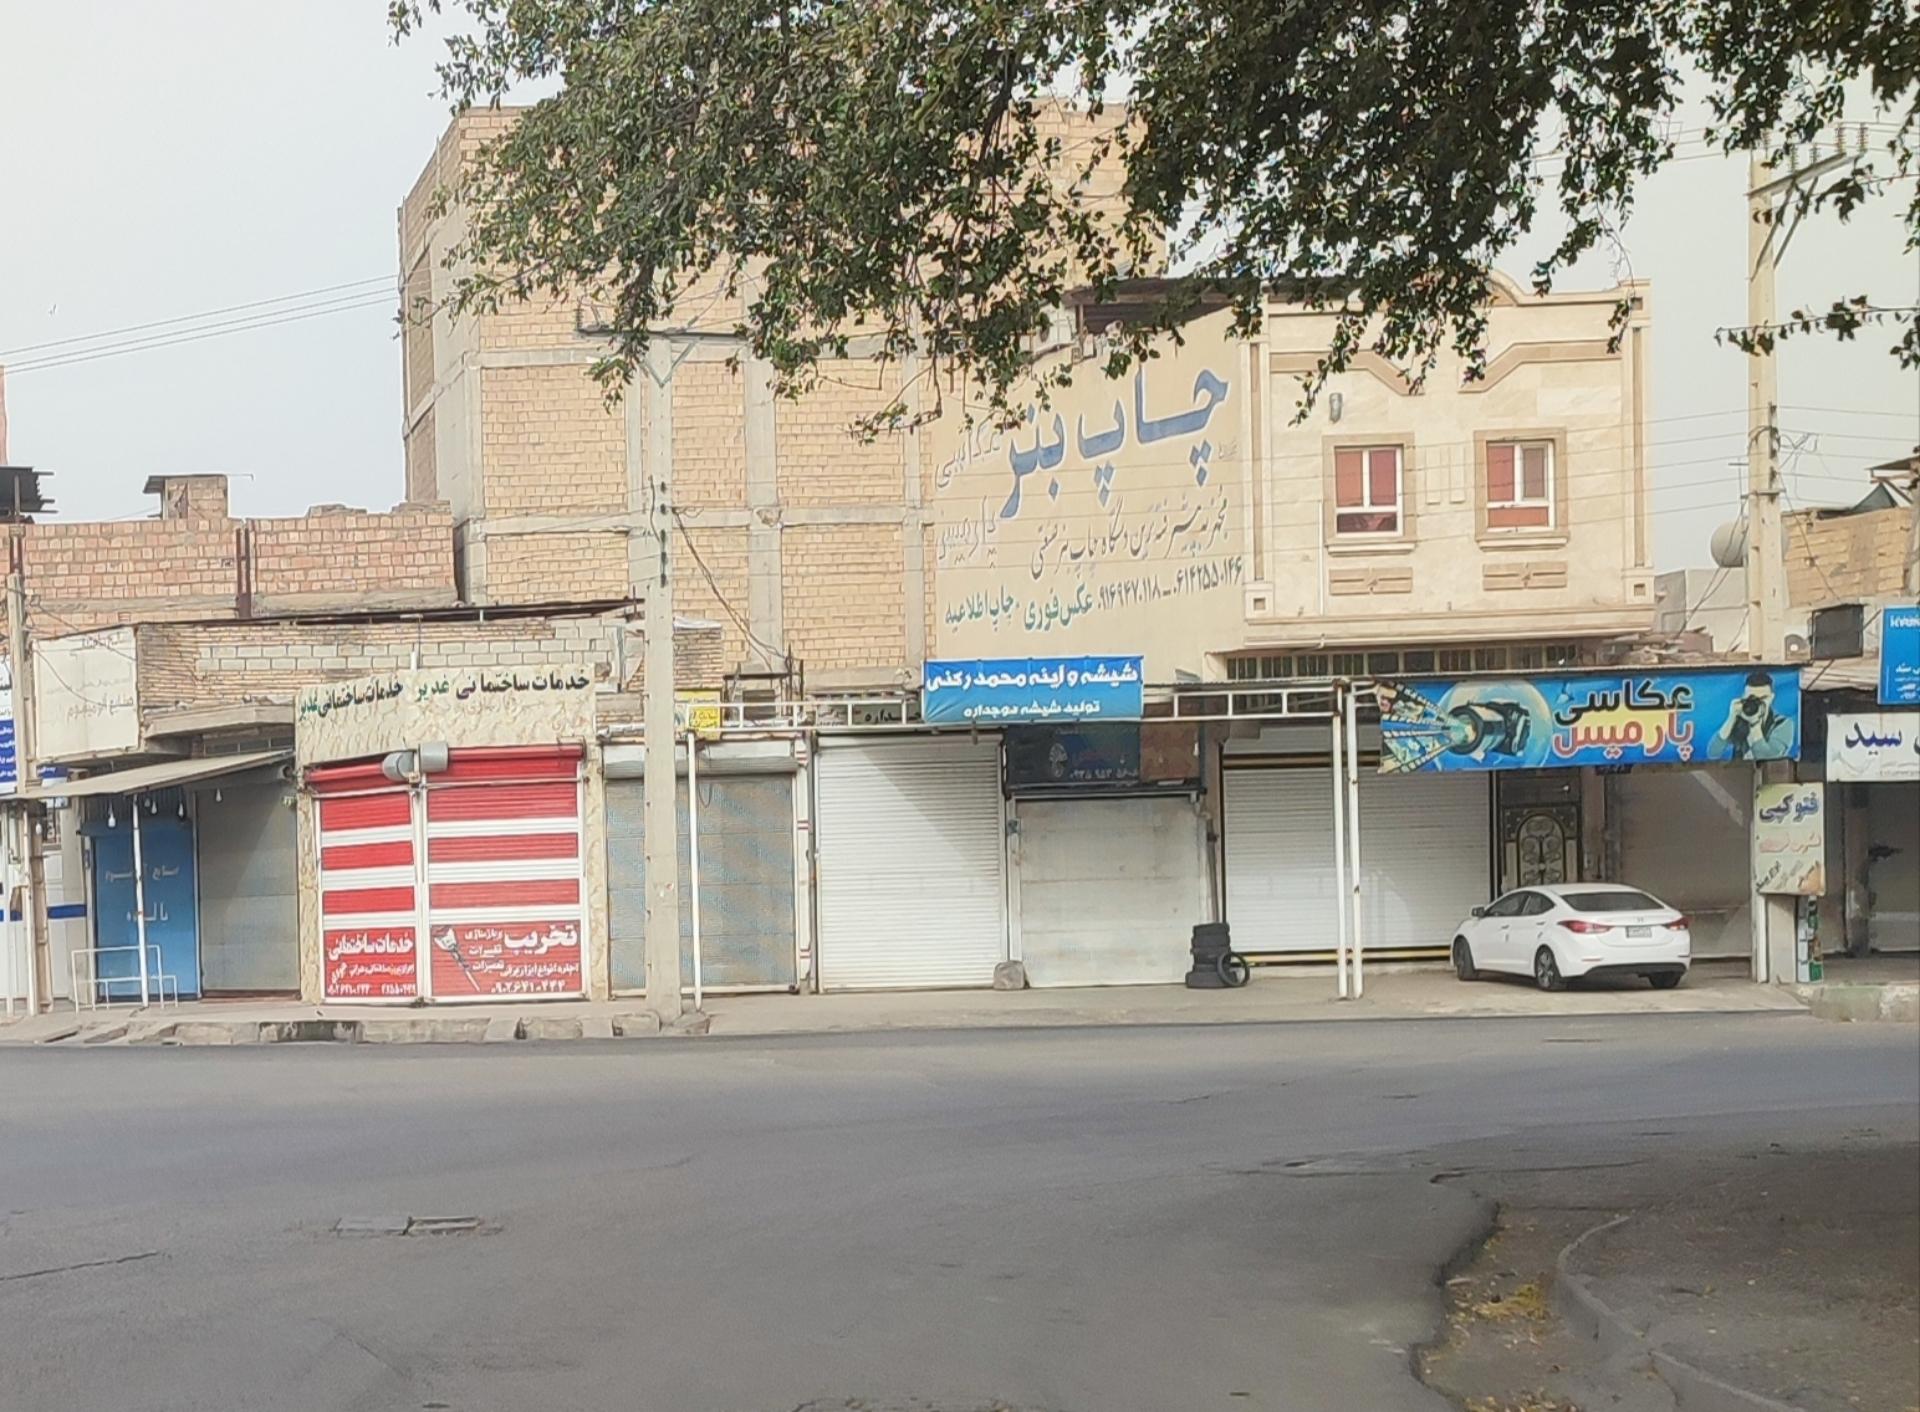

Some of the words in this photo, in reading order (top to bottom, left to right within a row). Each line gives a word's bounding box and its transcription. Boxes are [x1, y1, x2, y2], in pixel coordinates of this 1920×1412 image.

[1076, 364, 1230, 508] چاپ
[999, 402, 1067, 519] بنر
[1030, 519, 1059, 580] صنعتی
[1053, 523, 1071, 575] بنر
[1070, 524, 1098, 578] چاپ
[945, 589, 988, 632] اطلاعیه
[989, 585, 1015, 632] چاپ
[1023, 587, 1060, 631] فوری
[1060, 582, 1093, 626] عکس
[365, 675, 404, 702] خدمات
[415, 674, 449, 701] غدیر
[456, 670, 530, 700] ساختمانی
[532, 669, 590, 691] خدمات
[973, 670, 1027, 688] محمد
[1066, 670, 1077, 686] و
[1081, 663, 1139, 687] شیشه
[318, 684, 365, 718] ساختمانی
[1020, 700, 1062, 715] شیشه
[1063, 699, 1101, 714] تولید
[1553, 679, 1693, 727] عکاسی
[1553, 711, 1693, 761] پارمیس
[327, 932, 376, 961] ساختمانی
[375, 931, 414, 954] خدمات
[504, 925, 578, 955] تخریب
